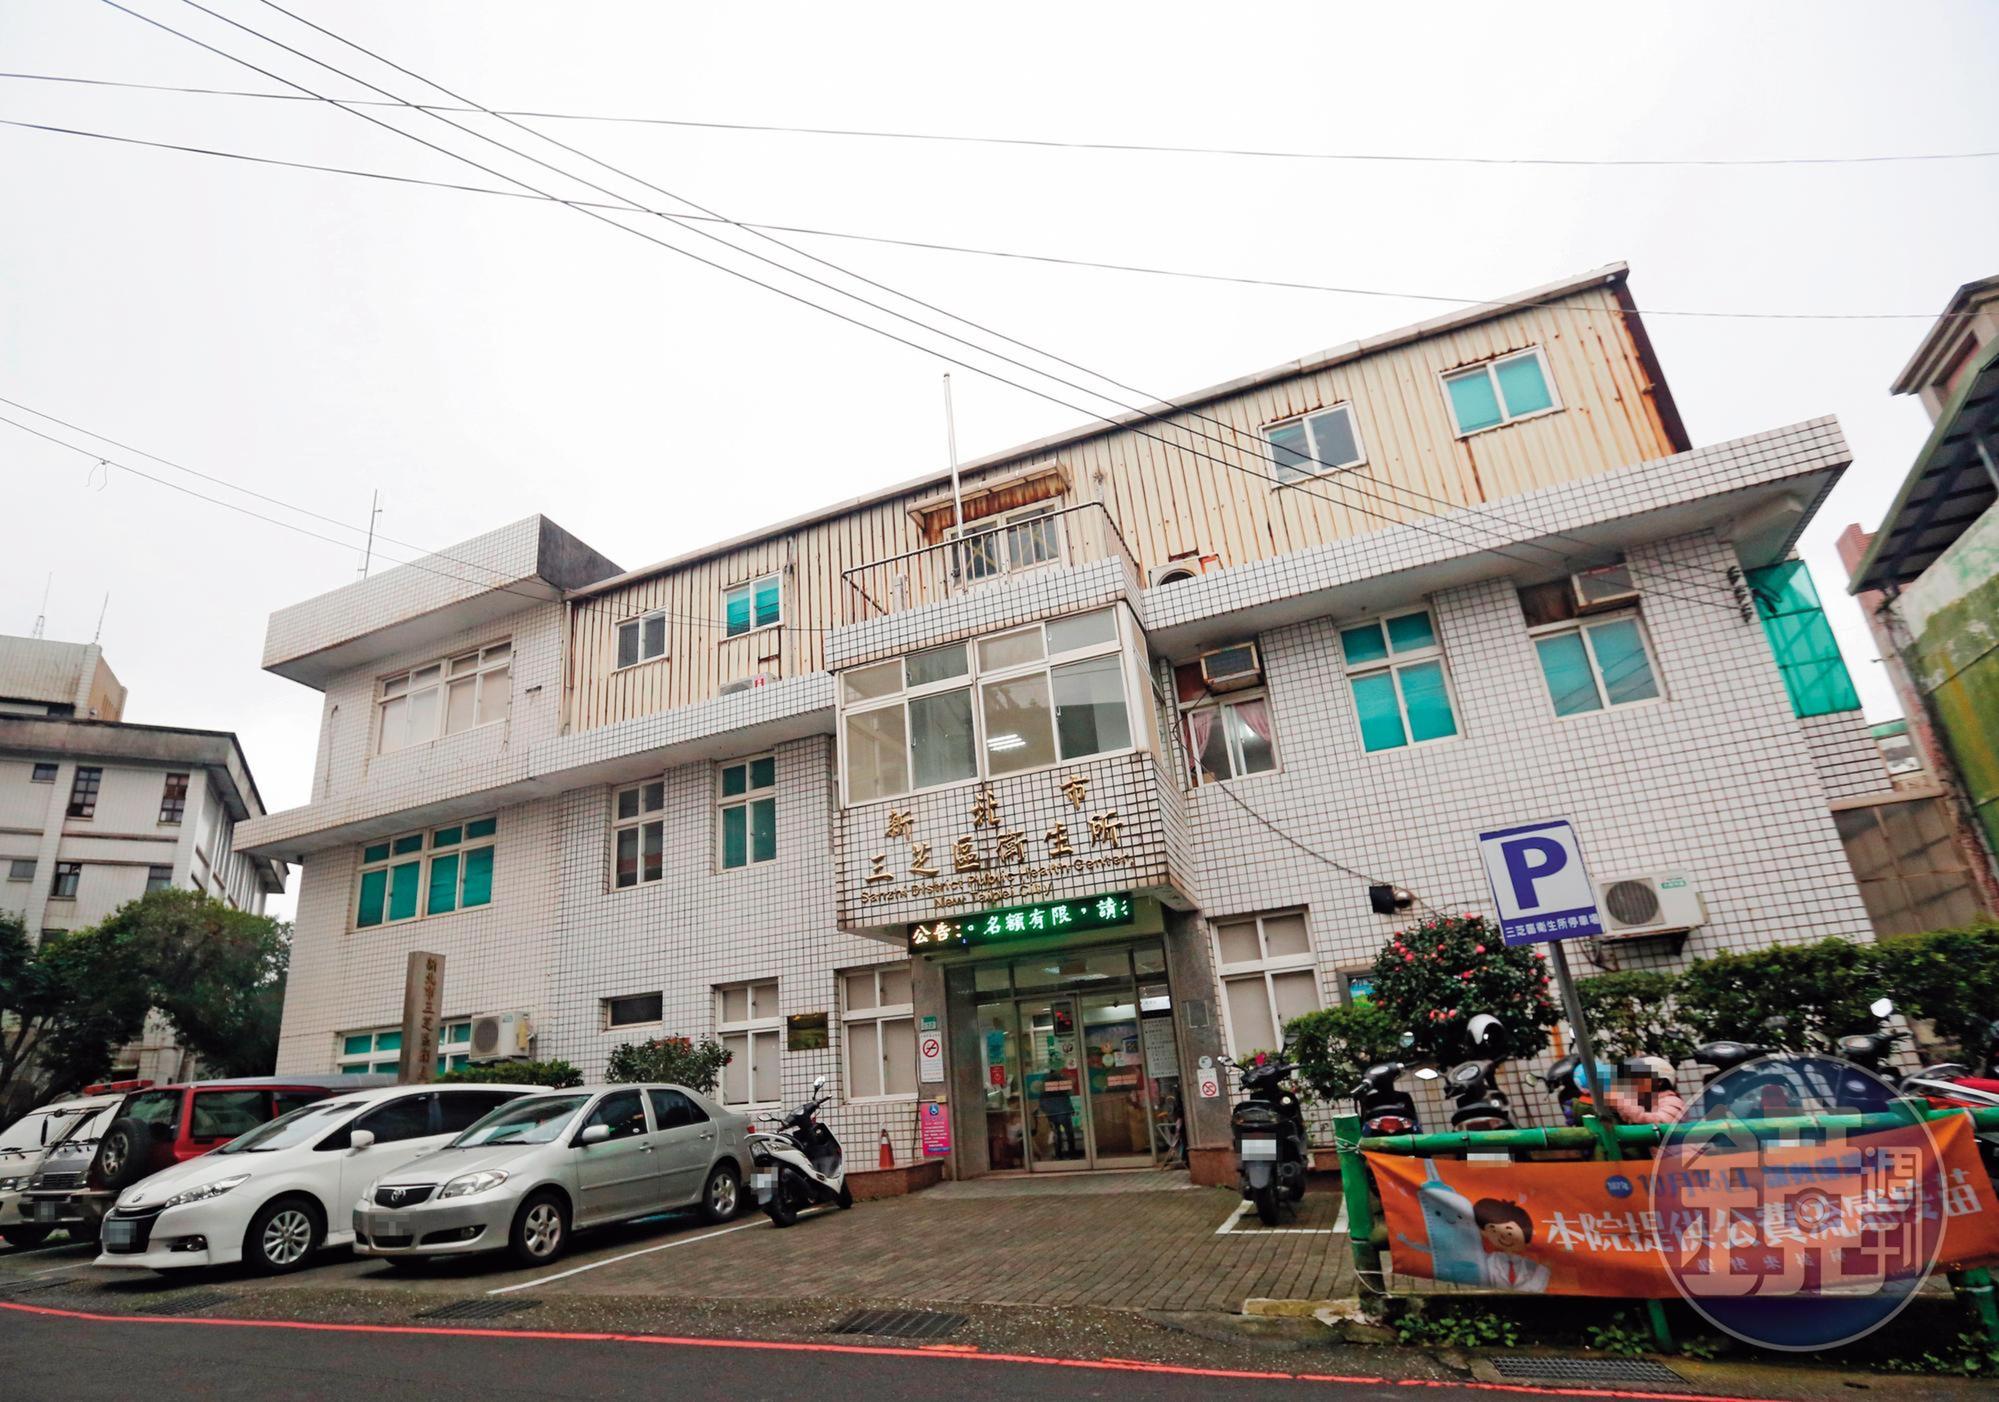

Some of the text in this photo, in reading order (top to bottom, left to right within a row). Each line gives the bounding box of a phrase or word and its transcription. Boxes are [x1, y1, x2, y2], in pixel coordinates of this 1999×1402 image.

[885, 775, 1090, 841] 新北市
[865, 809, 1124, 884] 三芝區衛生所
[911, 879, 963, 897] District
[968, 870, 1014, 891] Public
[1018, 861, 1070, 881] Health
[1501, 837, 1567, 910] P
[934, 894, 965, 909] New
[1020, 880, 1054, 897] City
